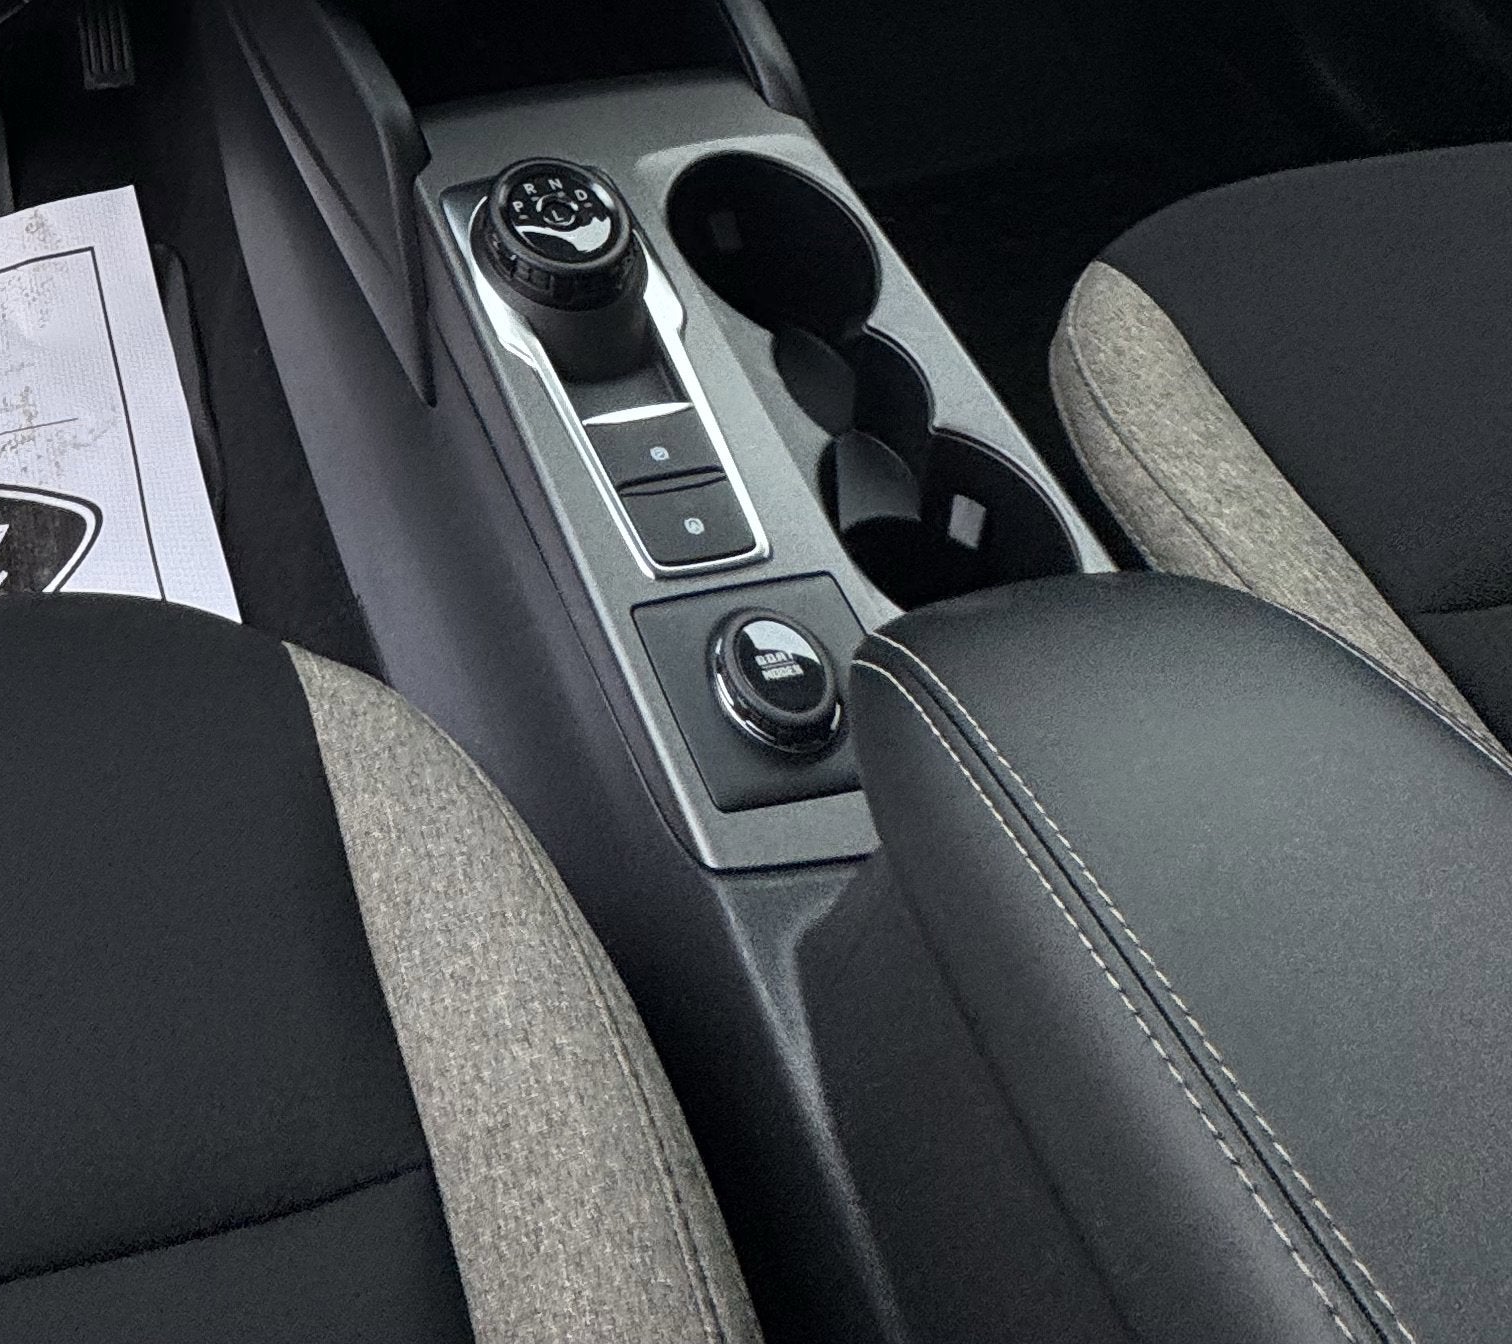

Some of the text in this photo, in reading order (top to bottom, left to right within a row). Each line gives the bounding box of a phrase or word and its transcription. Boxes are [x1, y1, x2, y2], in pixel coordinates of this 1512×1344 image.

[522, 183, 538, 195] R
[548, 178, 564, 191] N
[573, 189, 589, 202] D
[512, 200, 524, 213] P
[551, 209, 565, 222] L
